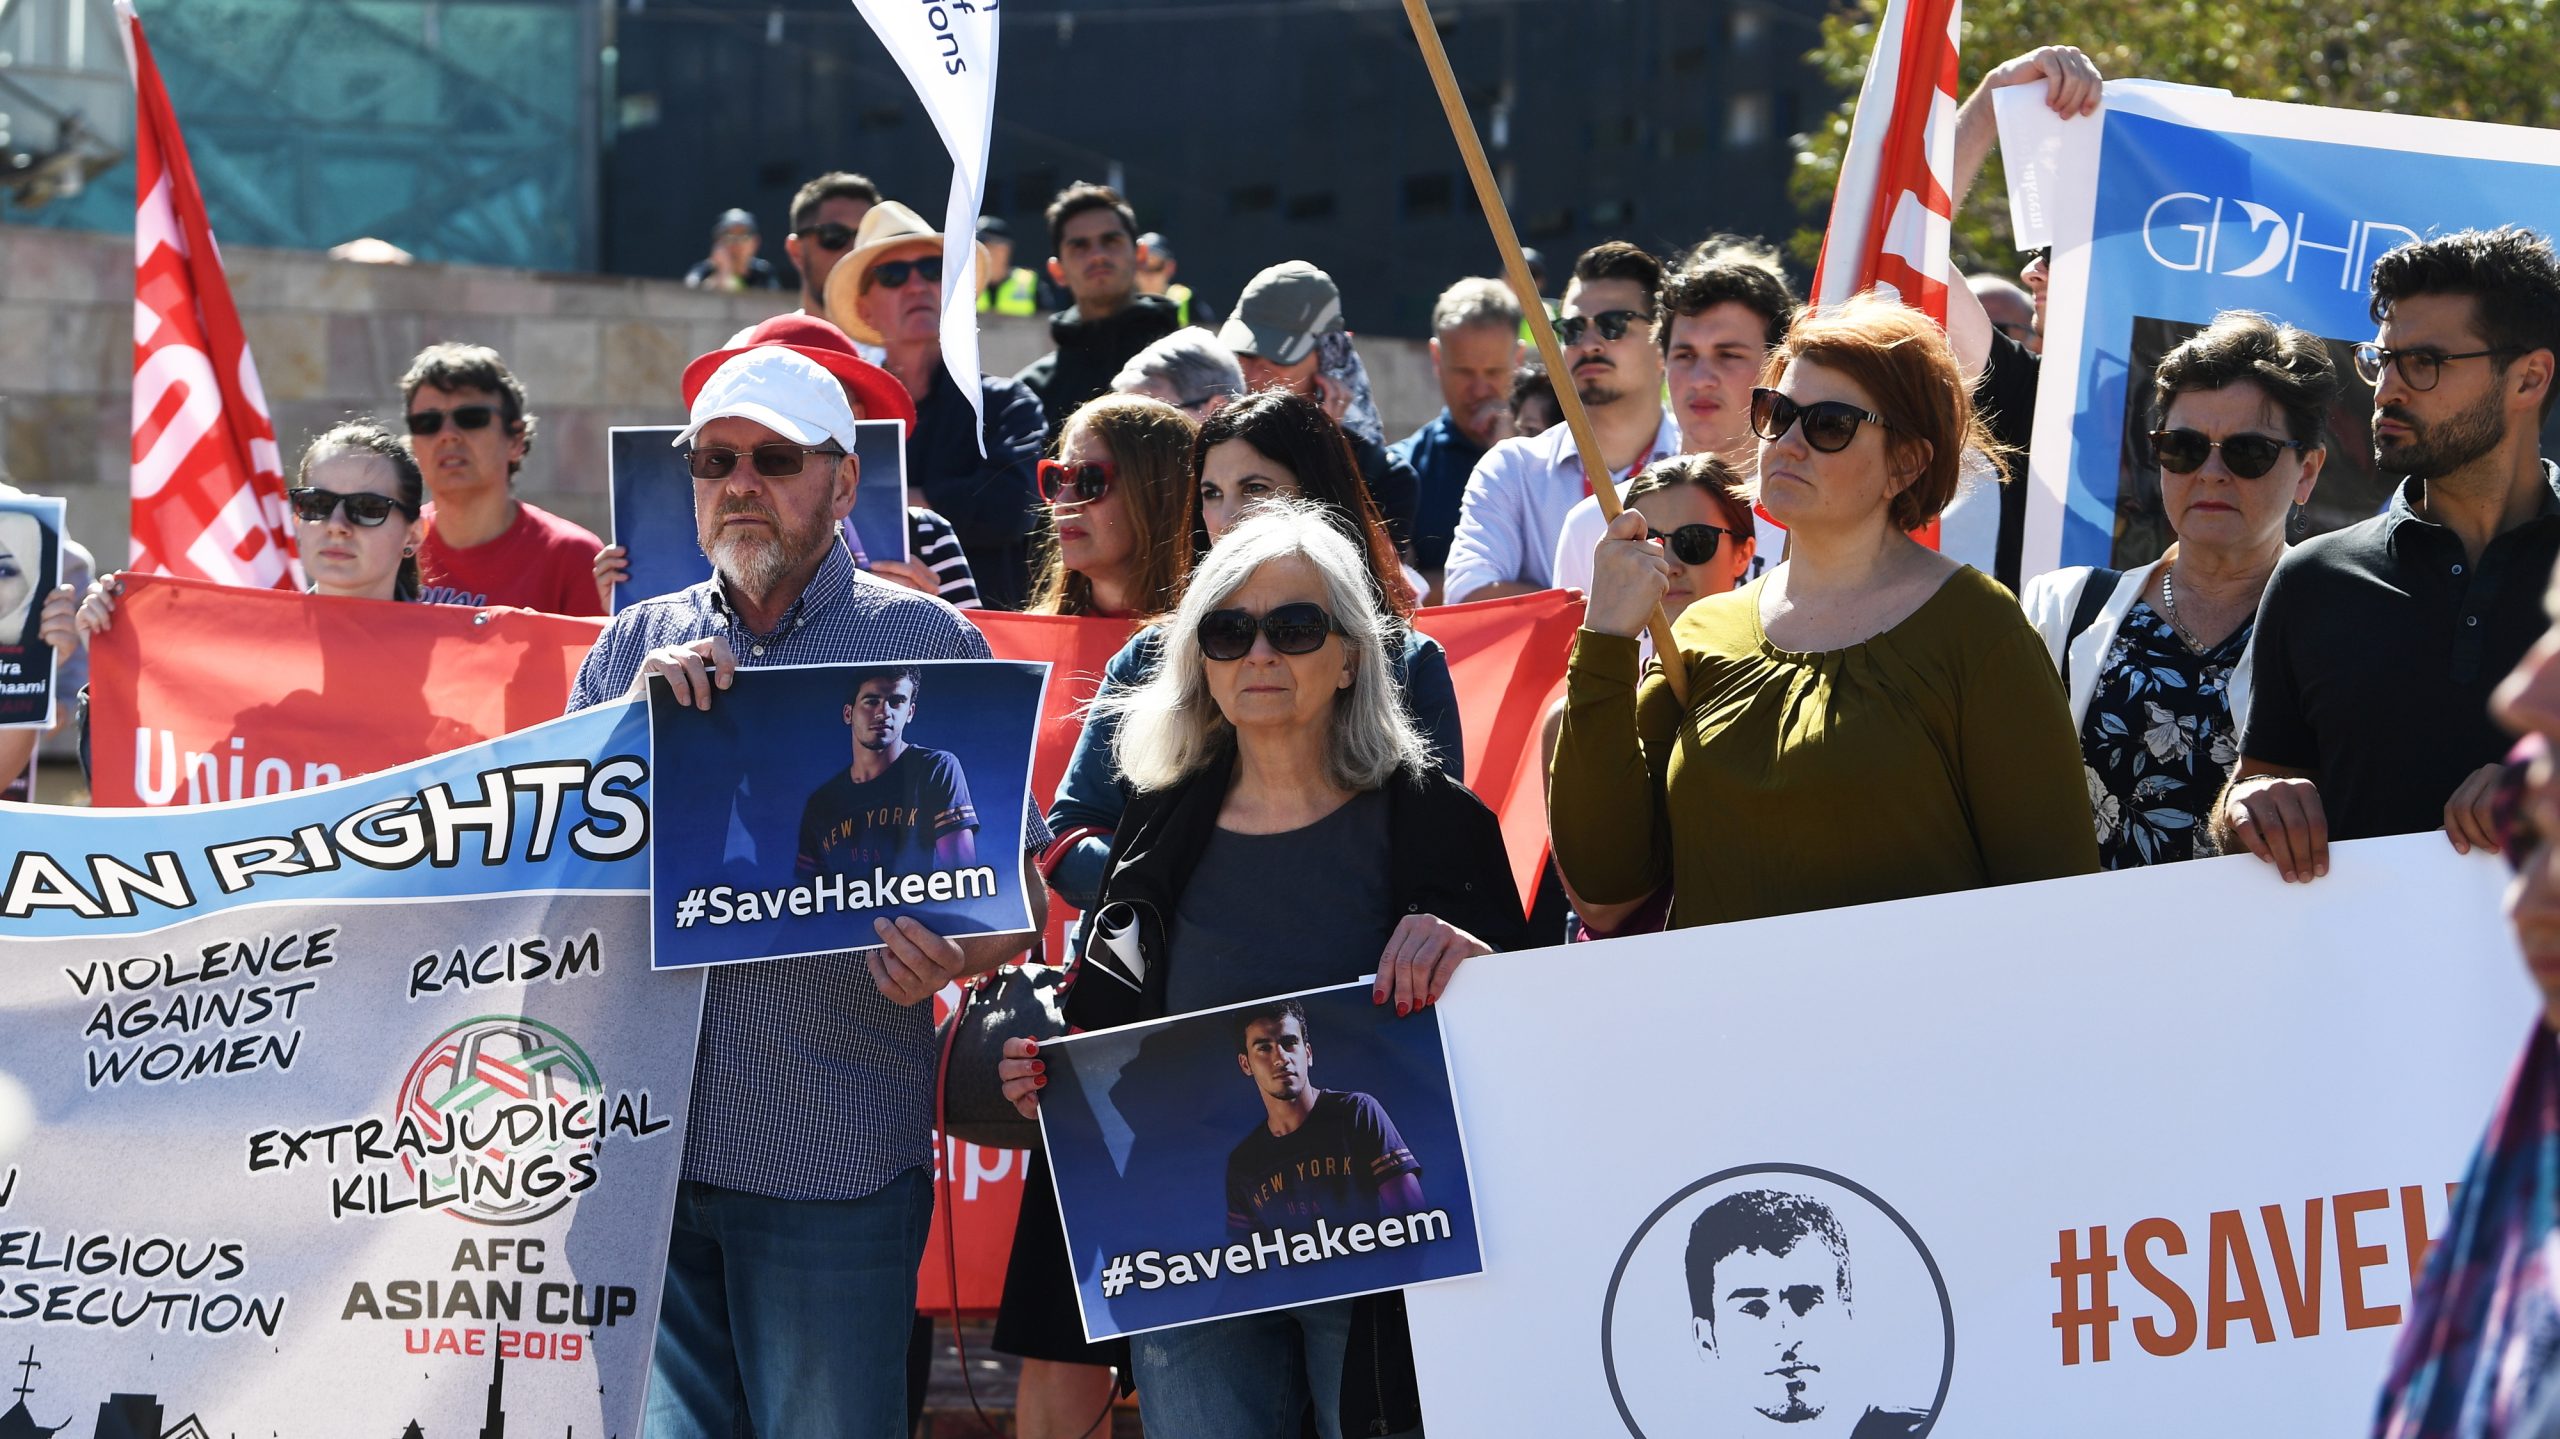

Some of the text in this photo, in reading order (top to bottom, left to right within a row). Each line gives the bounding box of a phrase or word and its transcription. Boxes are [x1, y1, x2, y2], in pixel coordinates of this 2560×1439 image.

[134, 726, 342, 806] Union
[205, 754, 650, 892] RIGHTS
[822, 806, 919, 855] NEW YORK
[675, 865, 997, 929] #SaveHakeem
[65, 928, 338, 996] VIOLENCE
[409, 932, 601, 999] RACISM
[85, 981, 316, 1040] AGAINST
[87, 1030, 302, 1089] WOMEN
[248, 1092, 671, 1172] EXTRAJUDICIAL
[332, 1153, 598, 1218] KILLINGS
[1253, 1156, 1352, 1208] NEW YORK
[451, 1238, 545, 1275] AFC
[1100, 1207, 1452, 1298] #SaveHakeem
[0, 1278, 285, 1337] SECUTION
[340, 1280, 637, 1328] ASIAN CUP
[405, 1328, 583, 1362] UAE 2019
